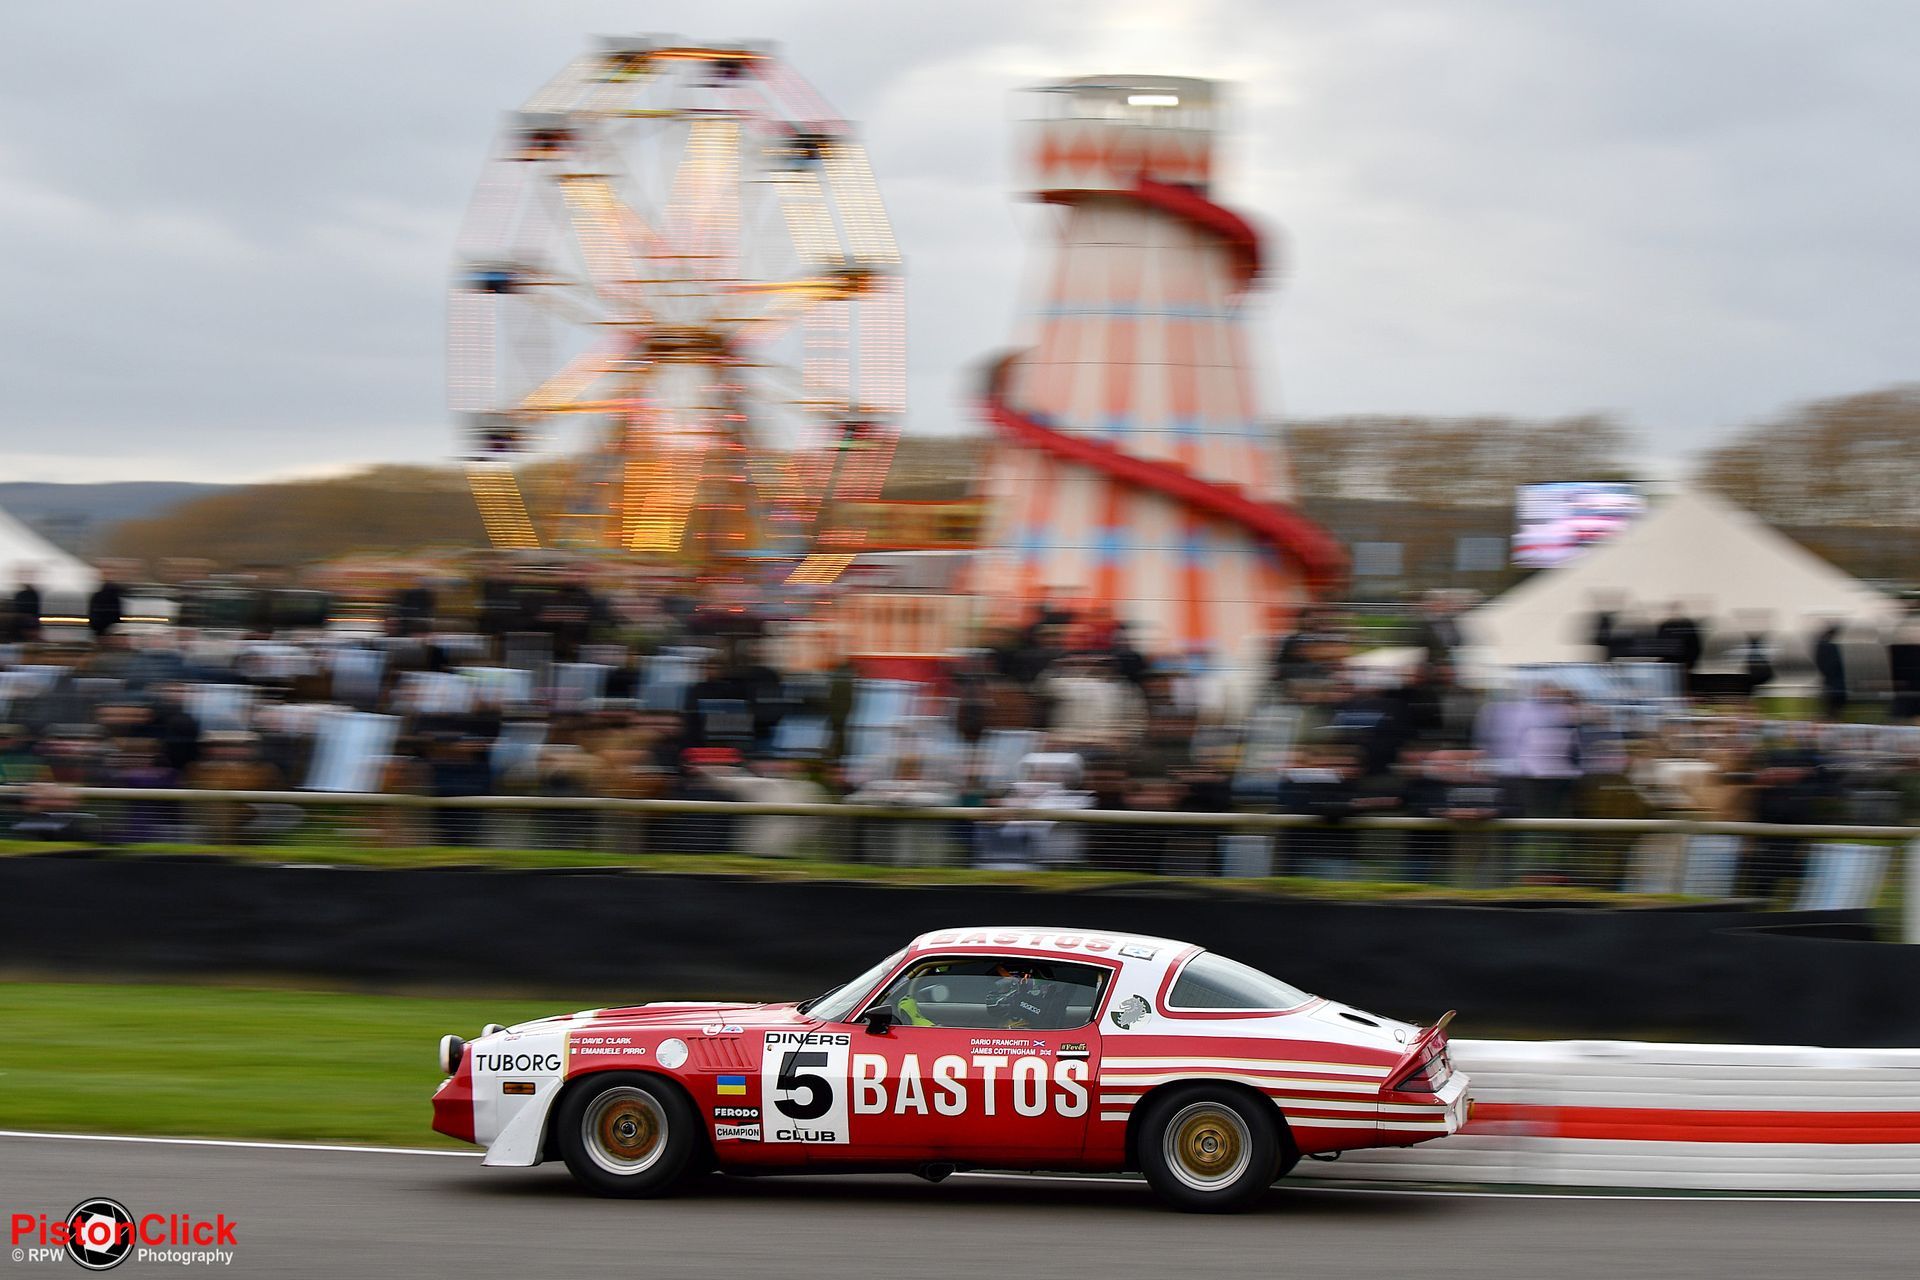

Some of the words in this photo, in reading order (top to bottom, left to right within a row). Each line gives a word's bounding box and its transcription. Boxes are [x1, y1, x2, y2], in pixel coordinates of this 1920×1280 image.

[929, 932, 1114, 952] BASTOS
[581, 1037, 604, 1045] DAVID
[605, 1037, 632, 1045] CLARK
[765, 1033, 849, 1045] DINERS
[991, 1039, 1030, 1047] FRANCHITTI
[580, 1047, 621, 1055] EMANUELE
[622, 1047, 646, 1055] PIRRO
[993, 1047, 1036, 1056] COTTINGHAM
[476, 1053, 561, 1072] TUBORG
[773, 1051, 834, 1120] 5
[852, 1053, 1089, 1117] BASTOS
[714, 1107, 759, 1118] FERODO
[716, 1127, 760, 1137] CHAMPION
[776, 1129, 836, 1142] CLUB
